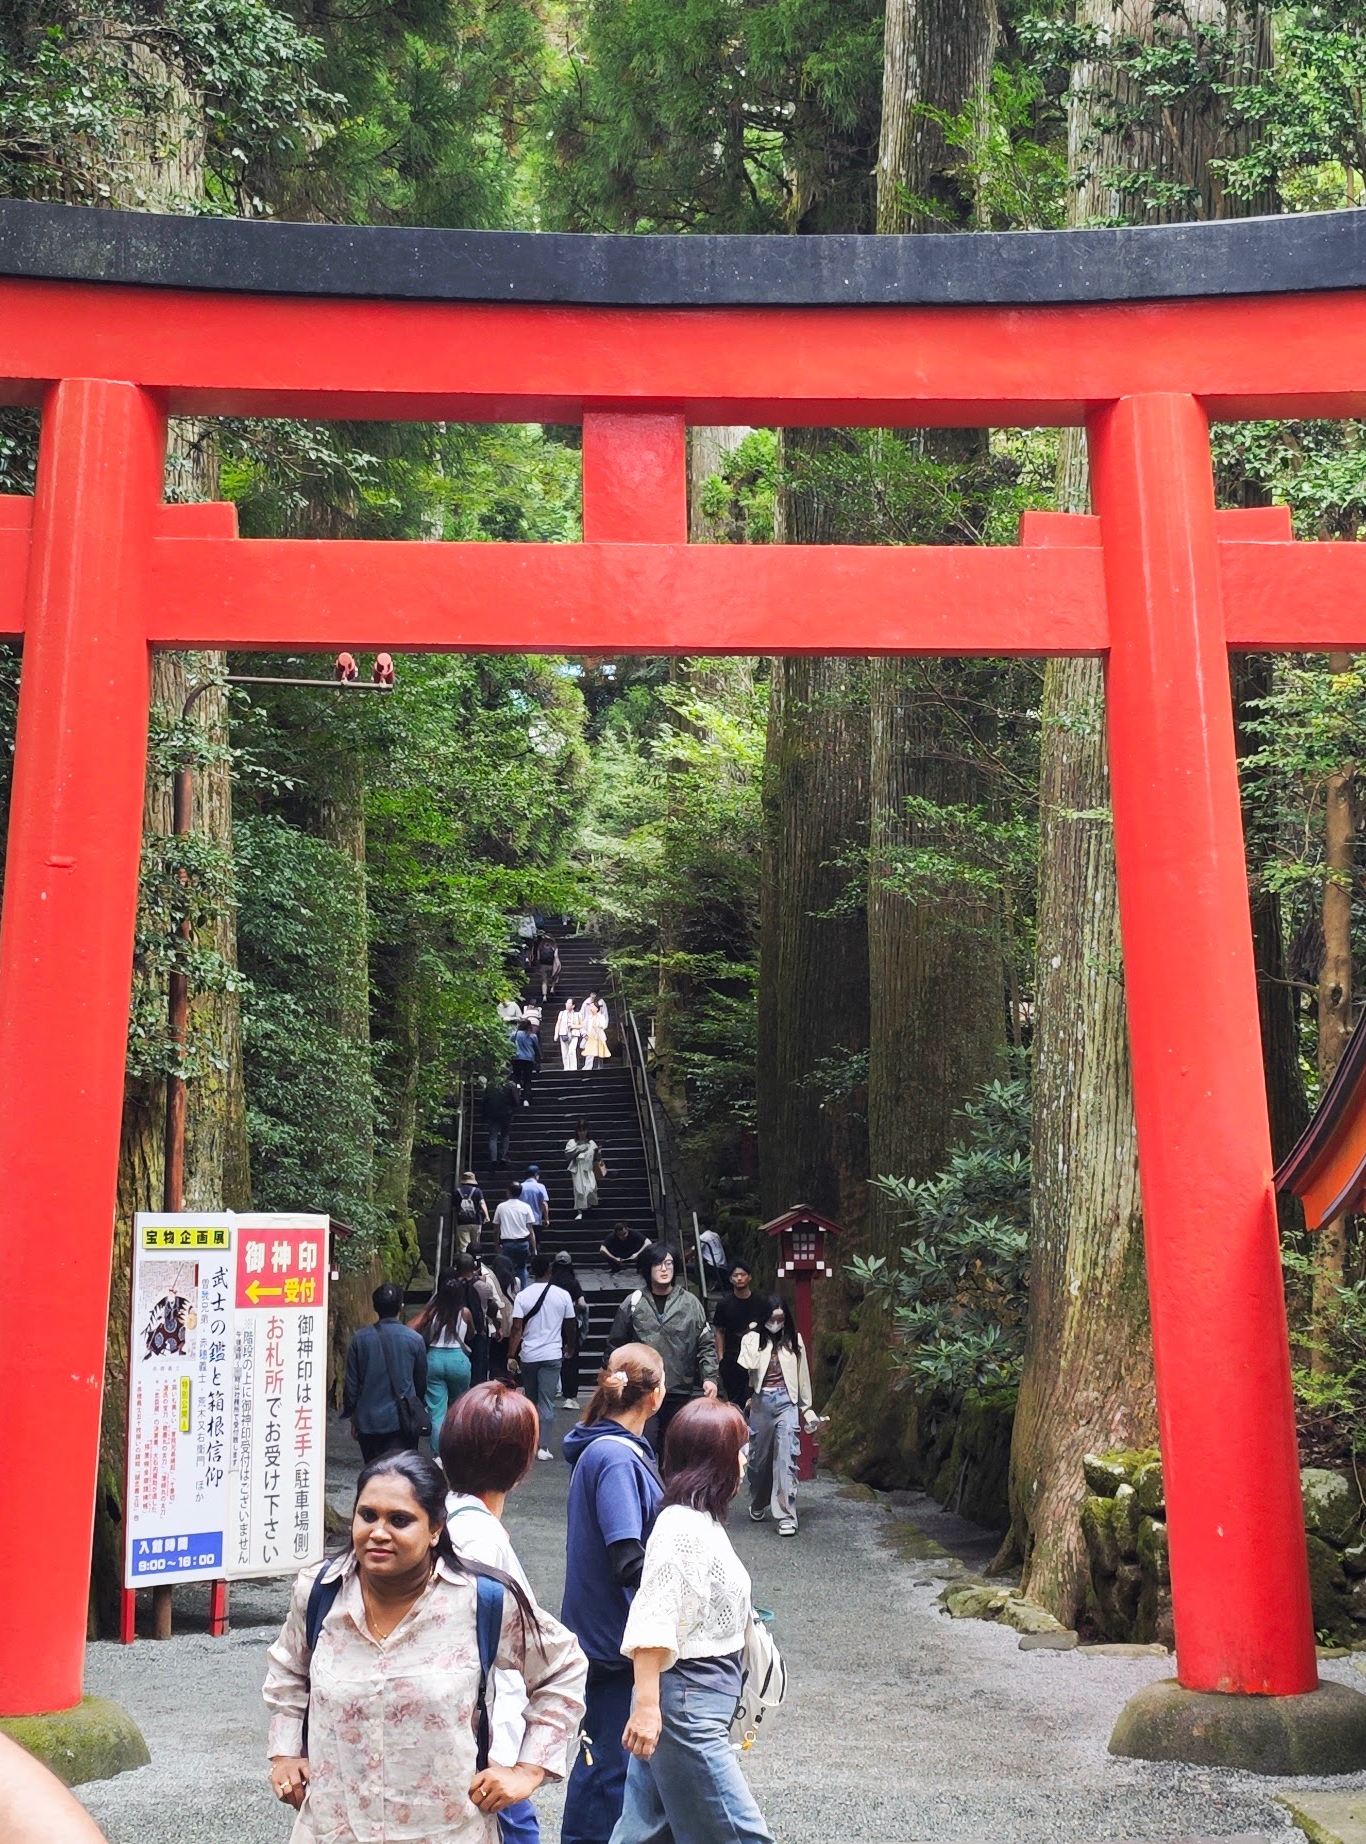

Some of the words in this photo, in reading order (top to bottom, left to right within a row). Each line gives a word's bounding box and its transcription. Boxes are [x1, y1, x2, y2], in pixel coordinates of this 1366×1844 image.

[145, 1229, 225, 1247] 宝物企画展
[244, 1241, 318, 1274] 御神印
[283, 1277, 316, 1304] 受付
[205, 1266, 228, 1488] 武士の鑑と箱根信仰
[262, 1316, 285, 1564] お札所でお受け下さい
[138, 1537, 189, 1555] 入館時間
